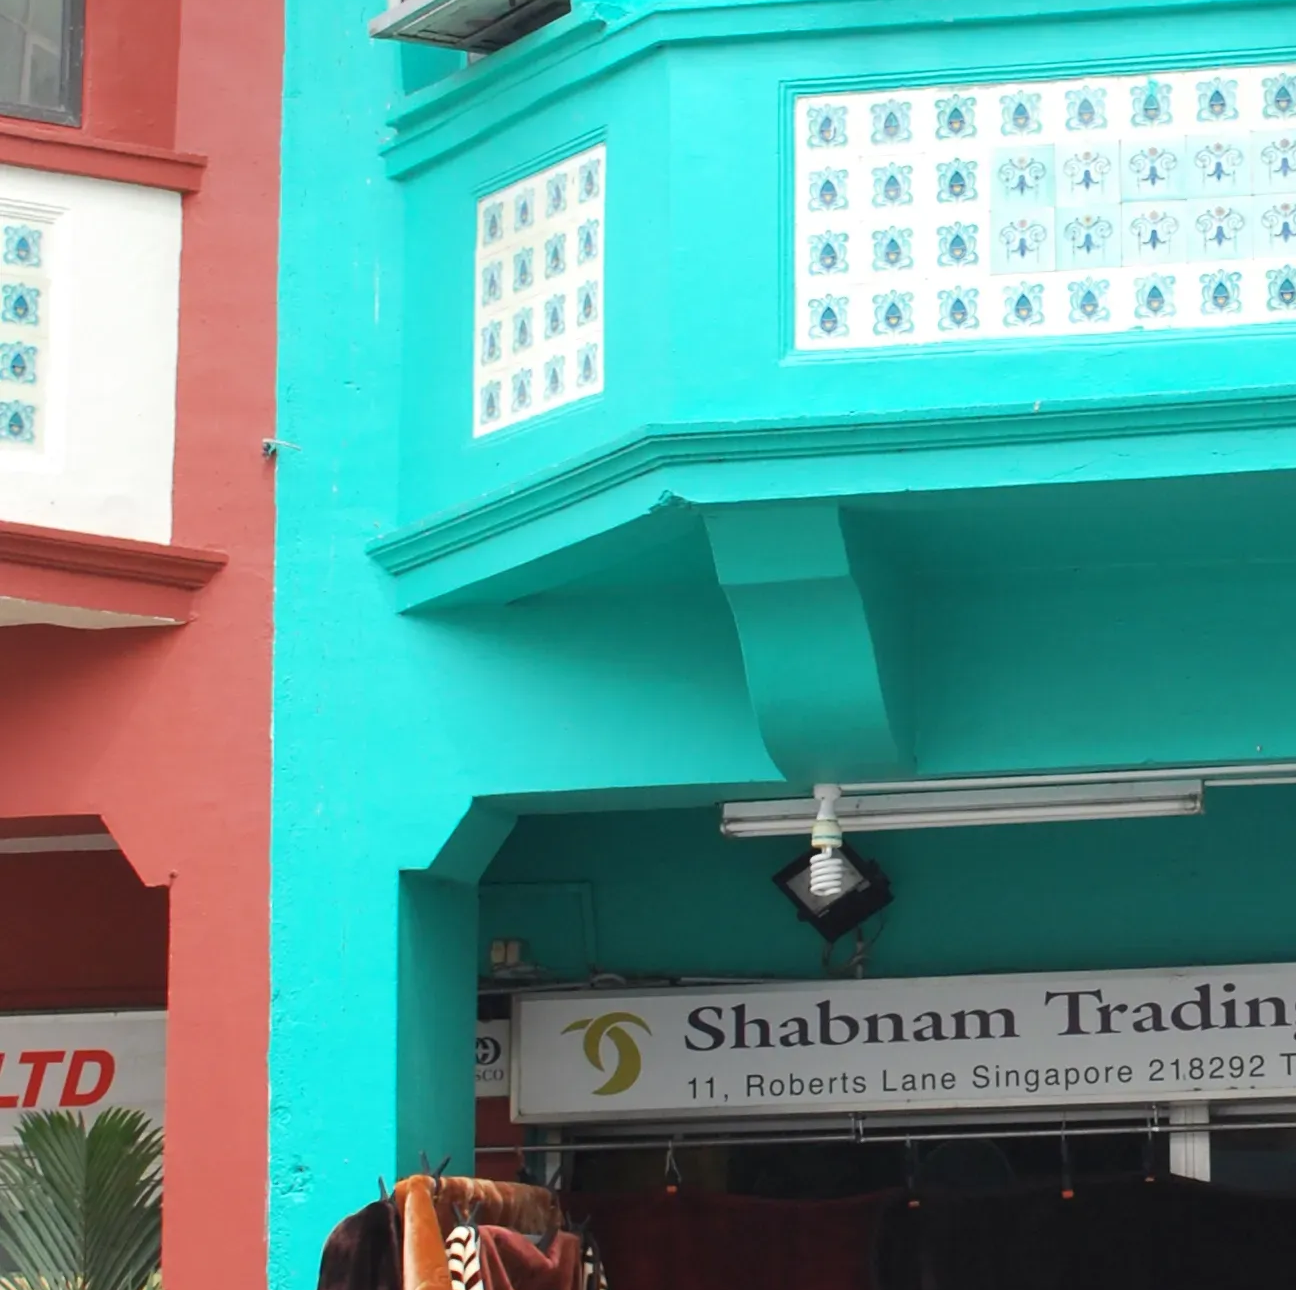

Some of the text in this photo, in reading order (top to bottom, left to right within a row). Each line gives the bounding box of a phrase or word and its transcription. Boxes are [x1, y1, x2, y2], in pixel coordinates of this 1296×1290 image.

[684, 999, 1021, 1052] Shabnam
[687, 1076, 730, 1103] 11,
[746, 1072, 867, 1098] Roberts
[882, 1069, 956, 1092] Lane
[972, 1063, 1133, 1094] Singapore
[1148, 1054, 1265, 1082] 218292
